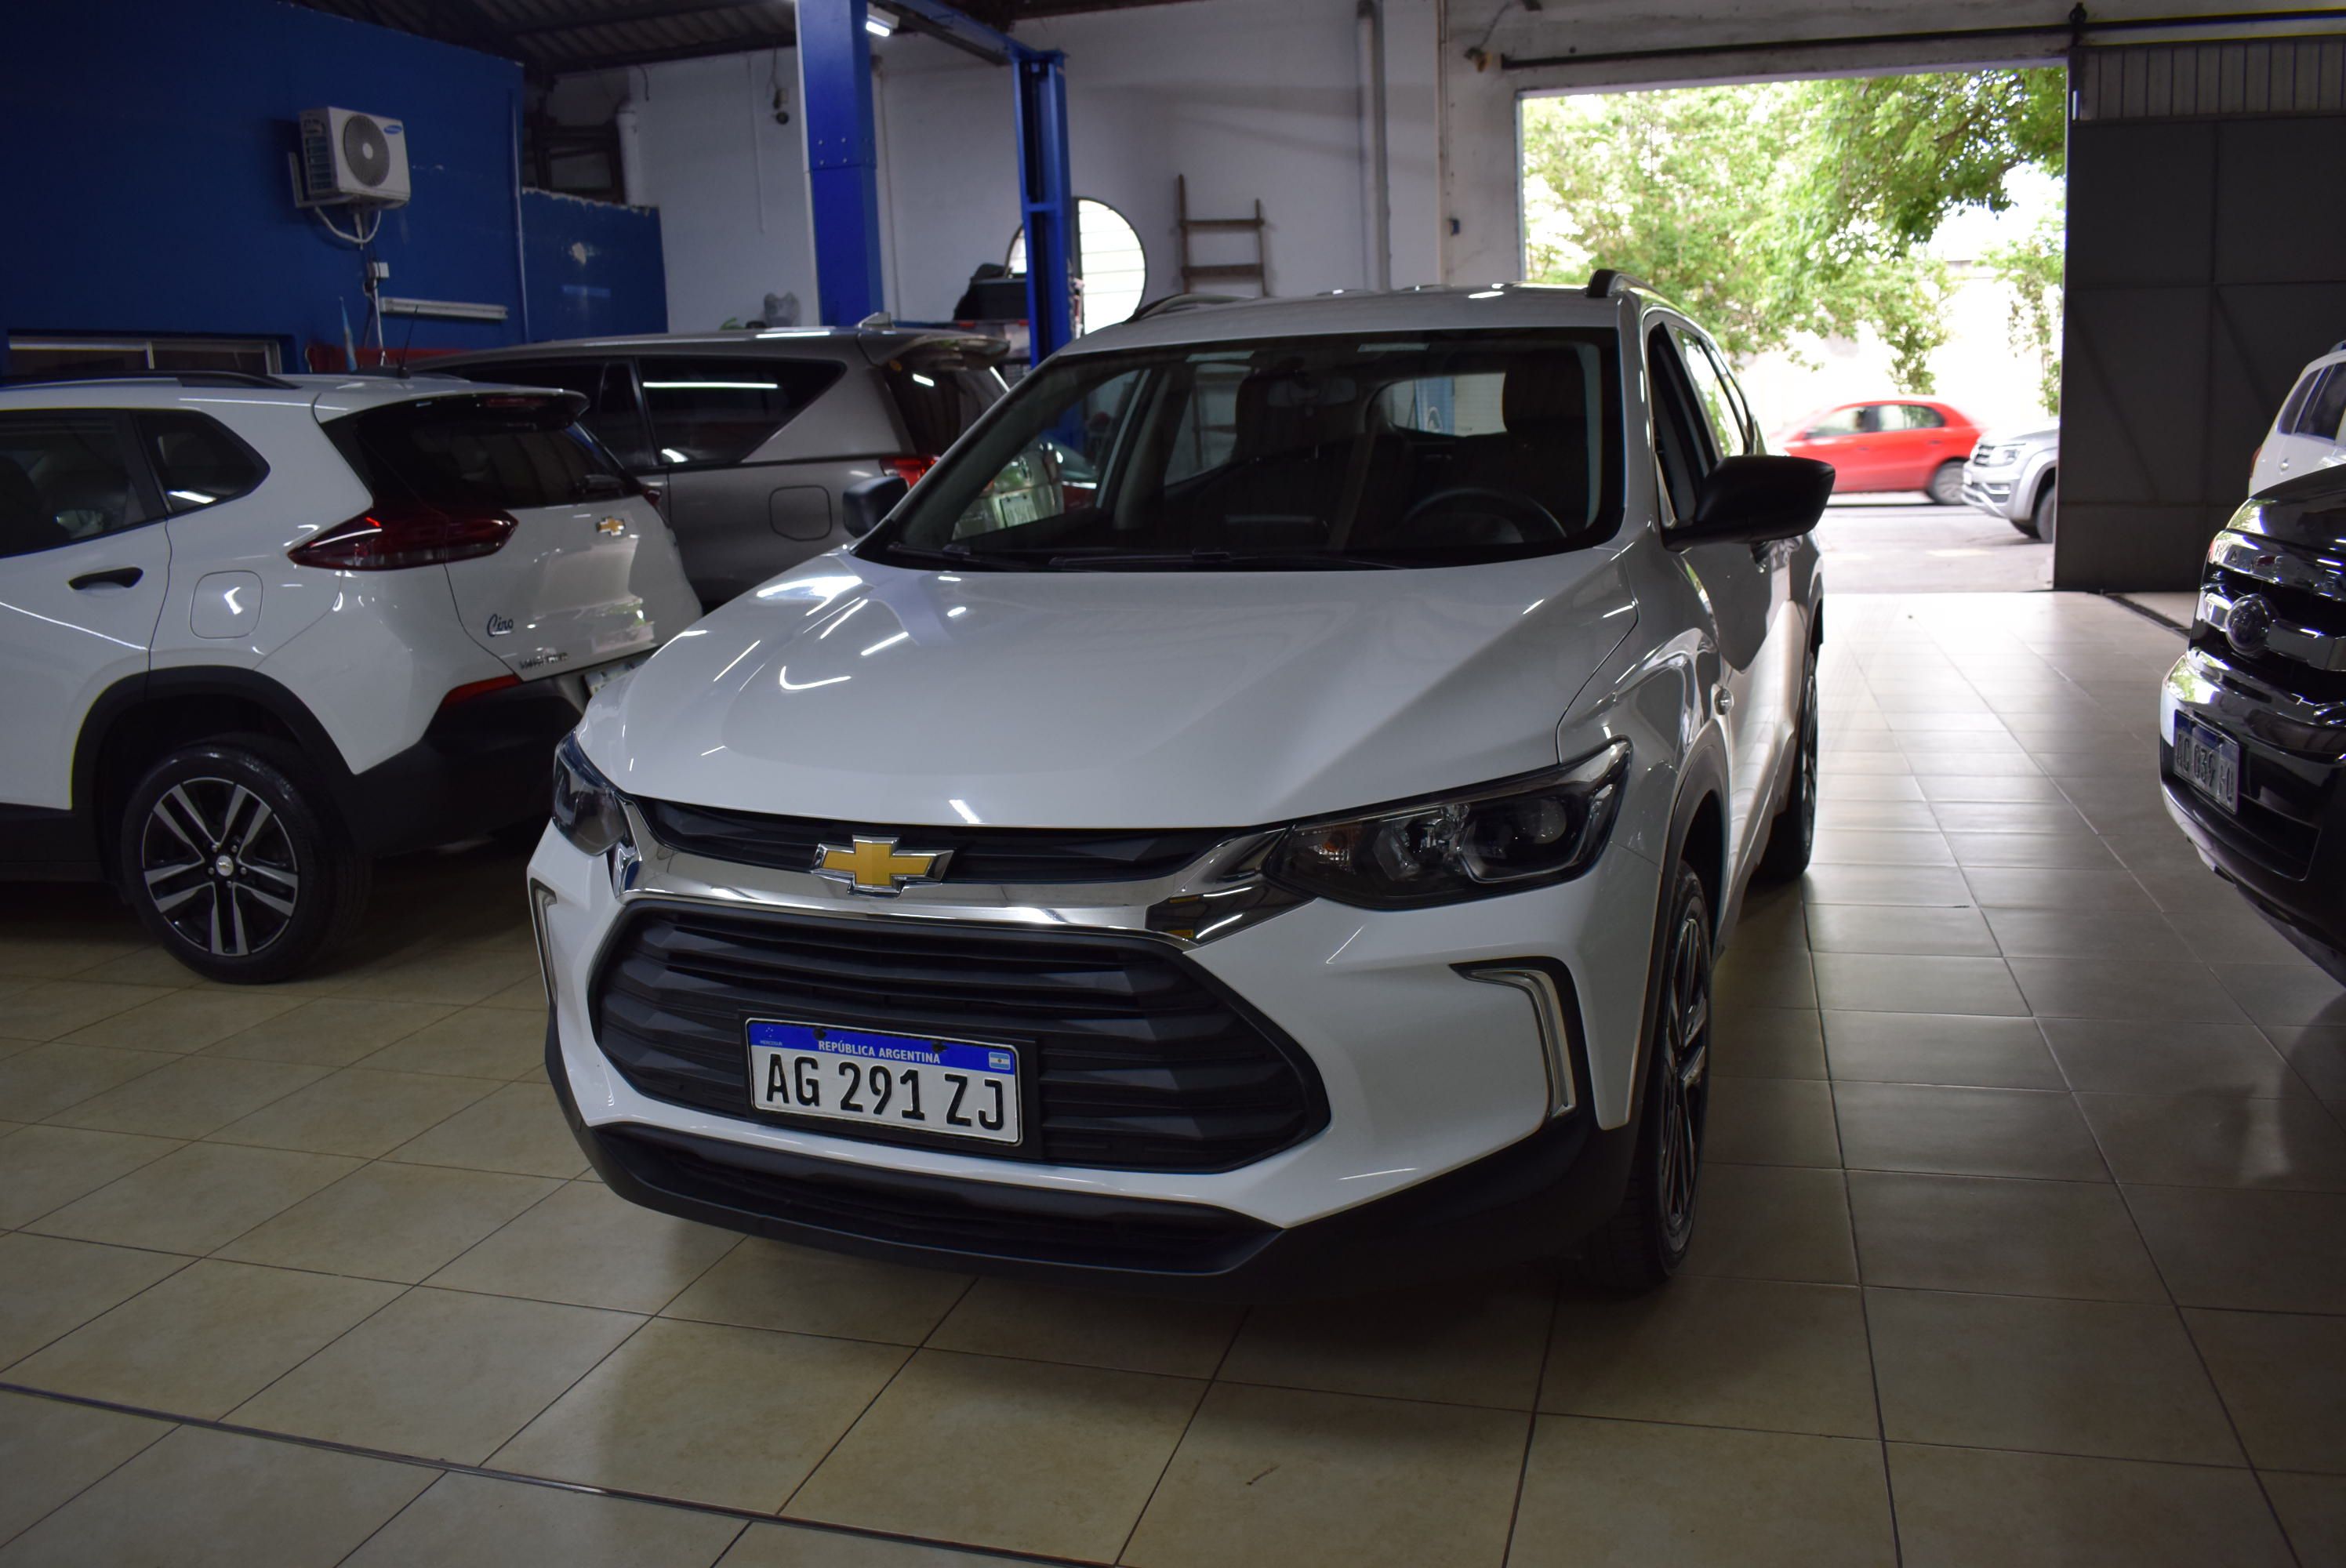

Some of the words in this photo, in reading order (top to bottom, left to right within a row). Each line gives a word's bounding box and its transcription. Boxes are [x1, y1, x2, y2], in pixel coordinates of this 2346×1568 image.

[819, 1040, 876, 1057] REPÚBLICA
[878, 1047, 941, 1064] ARGENTINA
[766, 1054, 820, 1106] AG
[838, 1062, 925, 1121] 291
[944, 1073, 1004, 1131] ZJ
